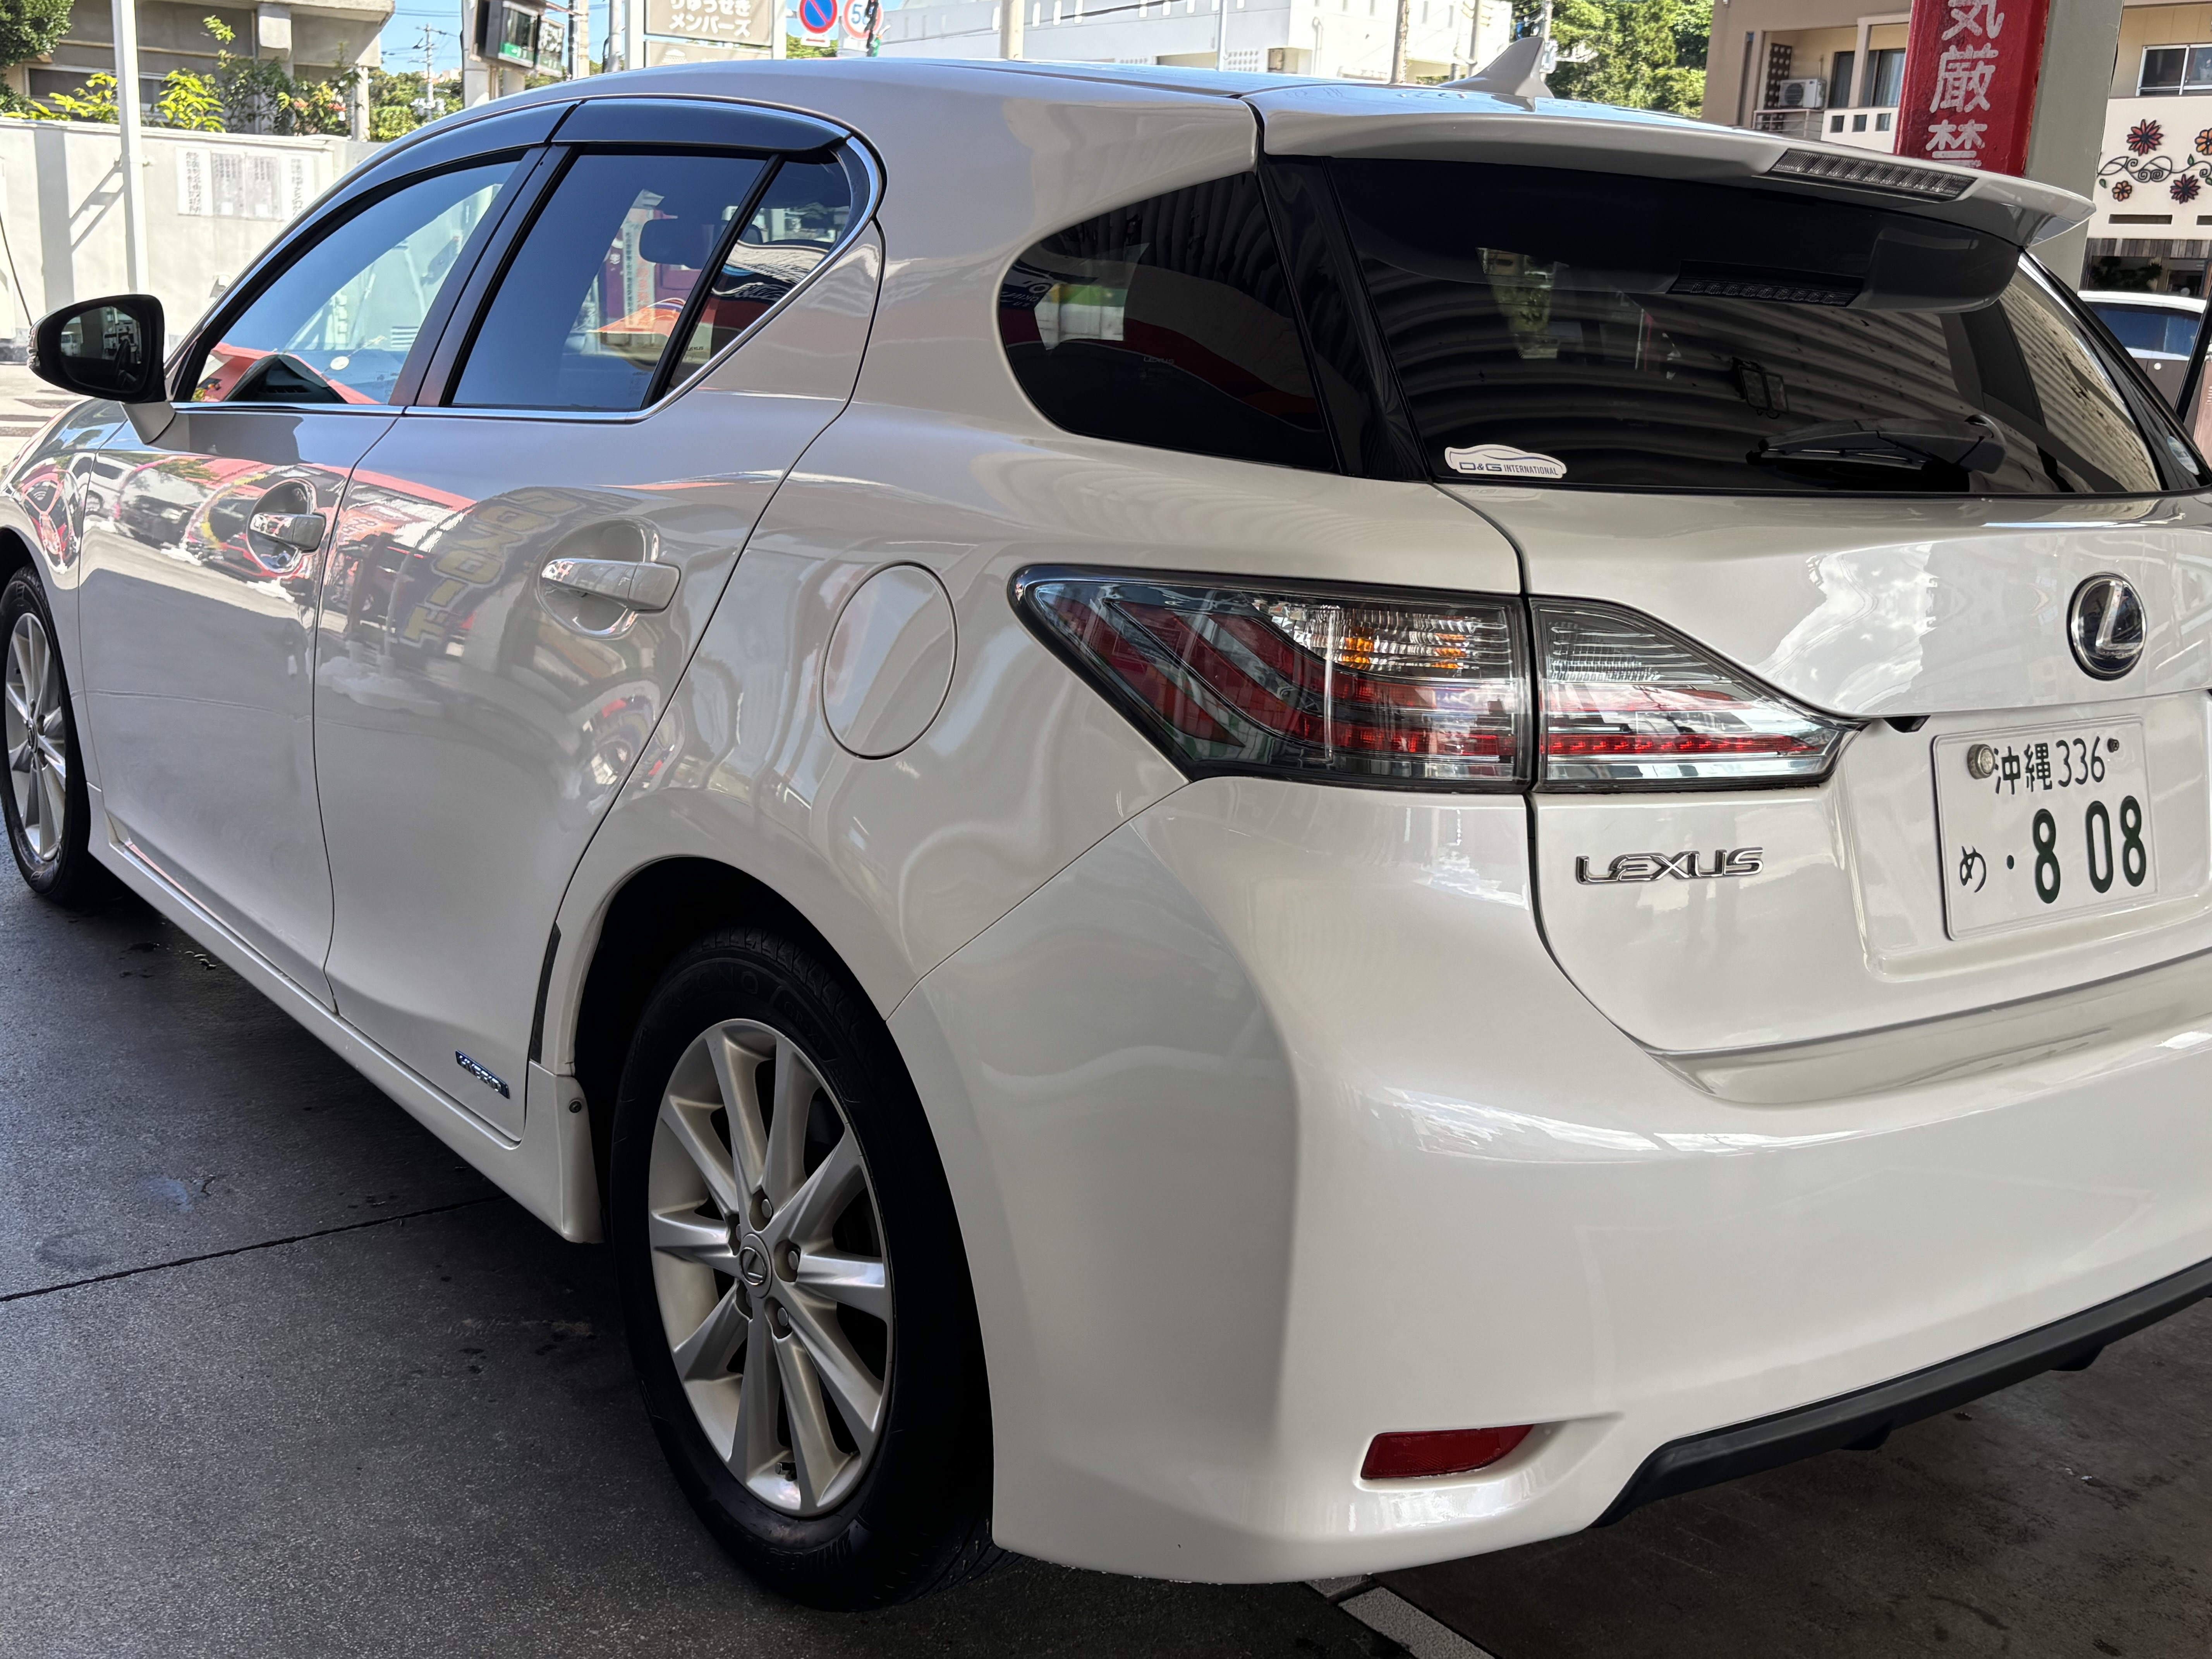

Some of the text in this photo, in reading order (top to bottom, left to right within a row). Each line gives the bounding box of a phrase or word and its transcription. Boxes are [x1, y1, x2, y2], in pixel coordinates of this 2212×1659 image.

[1459, 462, 1559, 475] D&G INTERNATIONAL
[1994, 743, 2052, 794] 沖縄
[2056, 736, 2105, 787] 336
[1576, 847, 1764, 884] LEXUS
[1959, 845, 1987, 893] め
